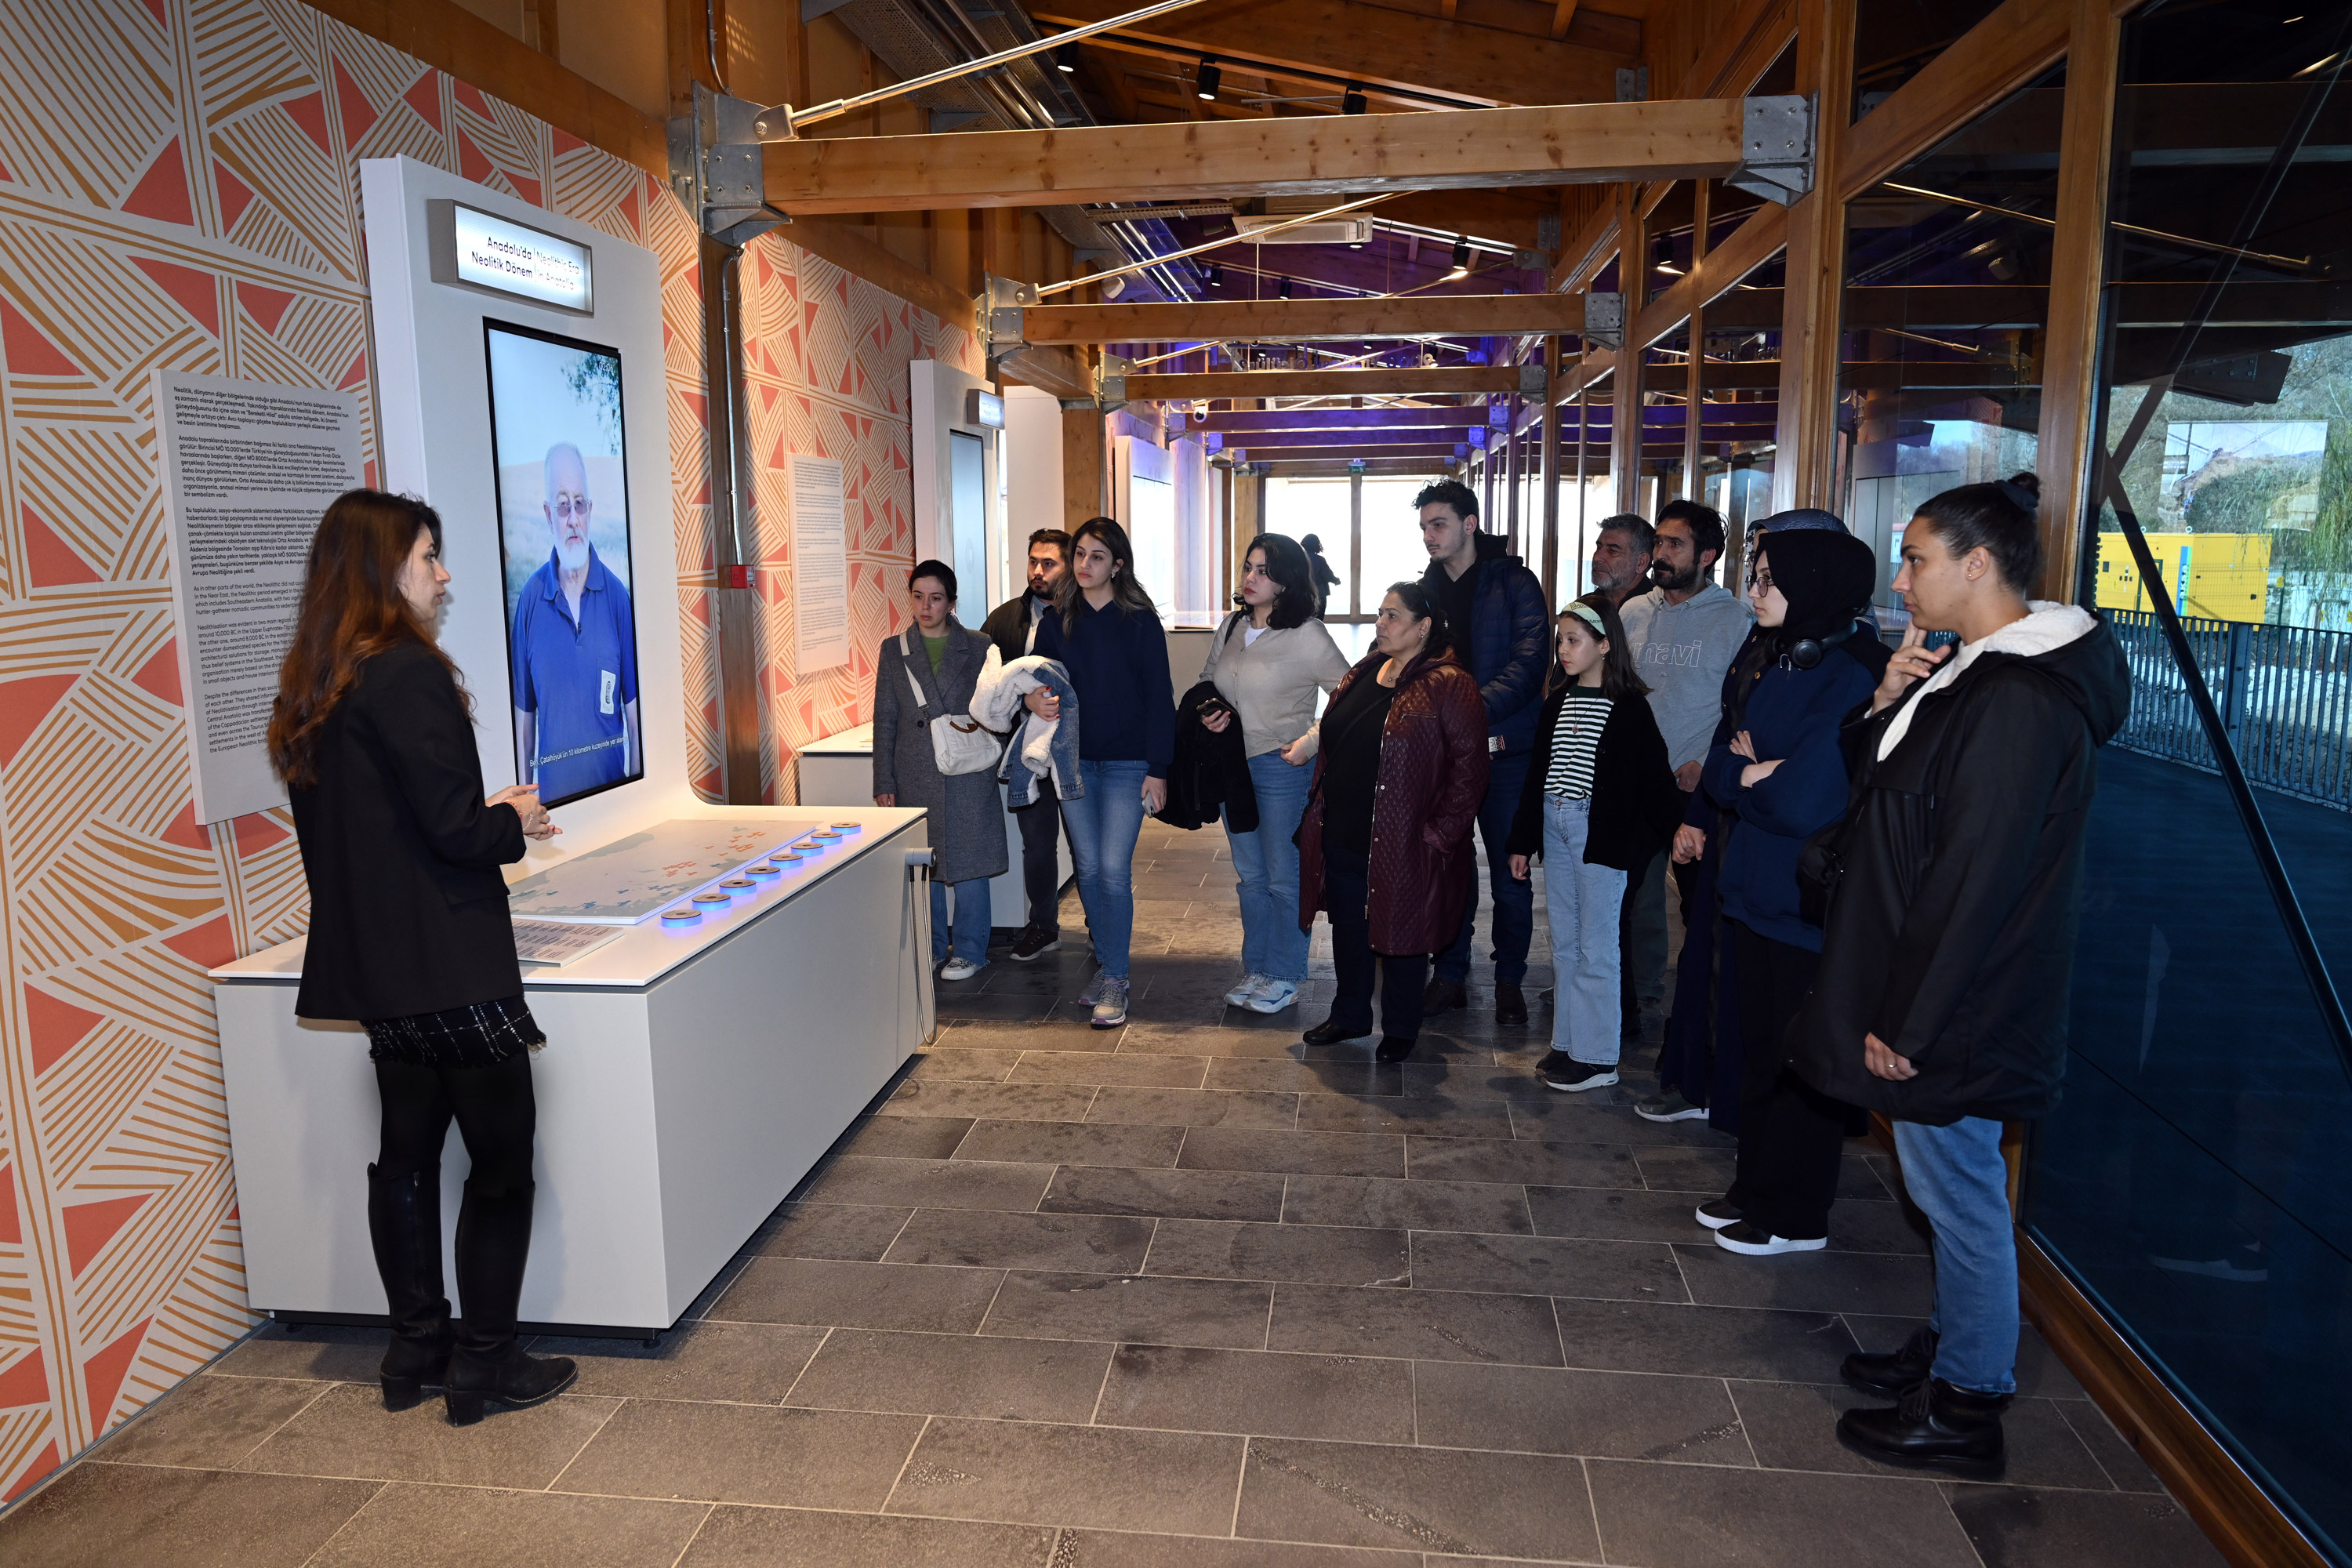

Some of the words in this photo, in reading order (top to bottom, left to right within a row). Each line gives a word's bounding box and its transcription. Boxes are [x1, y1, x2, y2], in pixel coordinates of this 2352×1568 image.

[487, 237, 532, 260] Anadolu'da
[471, 251, 504, 271] Neolitik
[506, 260, 533, 278] Dönem
[536, 251, 568, 272] Neolithic
[568, 260, 579, 274] Era
[536, 269, 544, 283] in
[546, 272, 575, 290] Anatolia
[211, 706, 241, 714] Neolithisation
[220, 719, 249, 728] Cappadocian
[209, 737, 234, 746] settlements
[540, 750, 568, 766] Çatalhöyük'ün
[574, 744, 591, 755] kilometre
[591, 741, 610, 751] kuzeyinde
